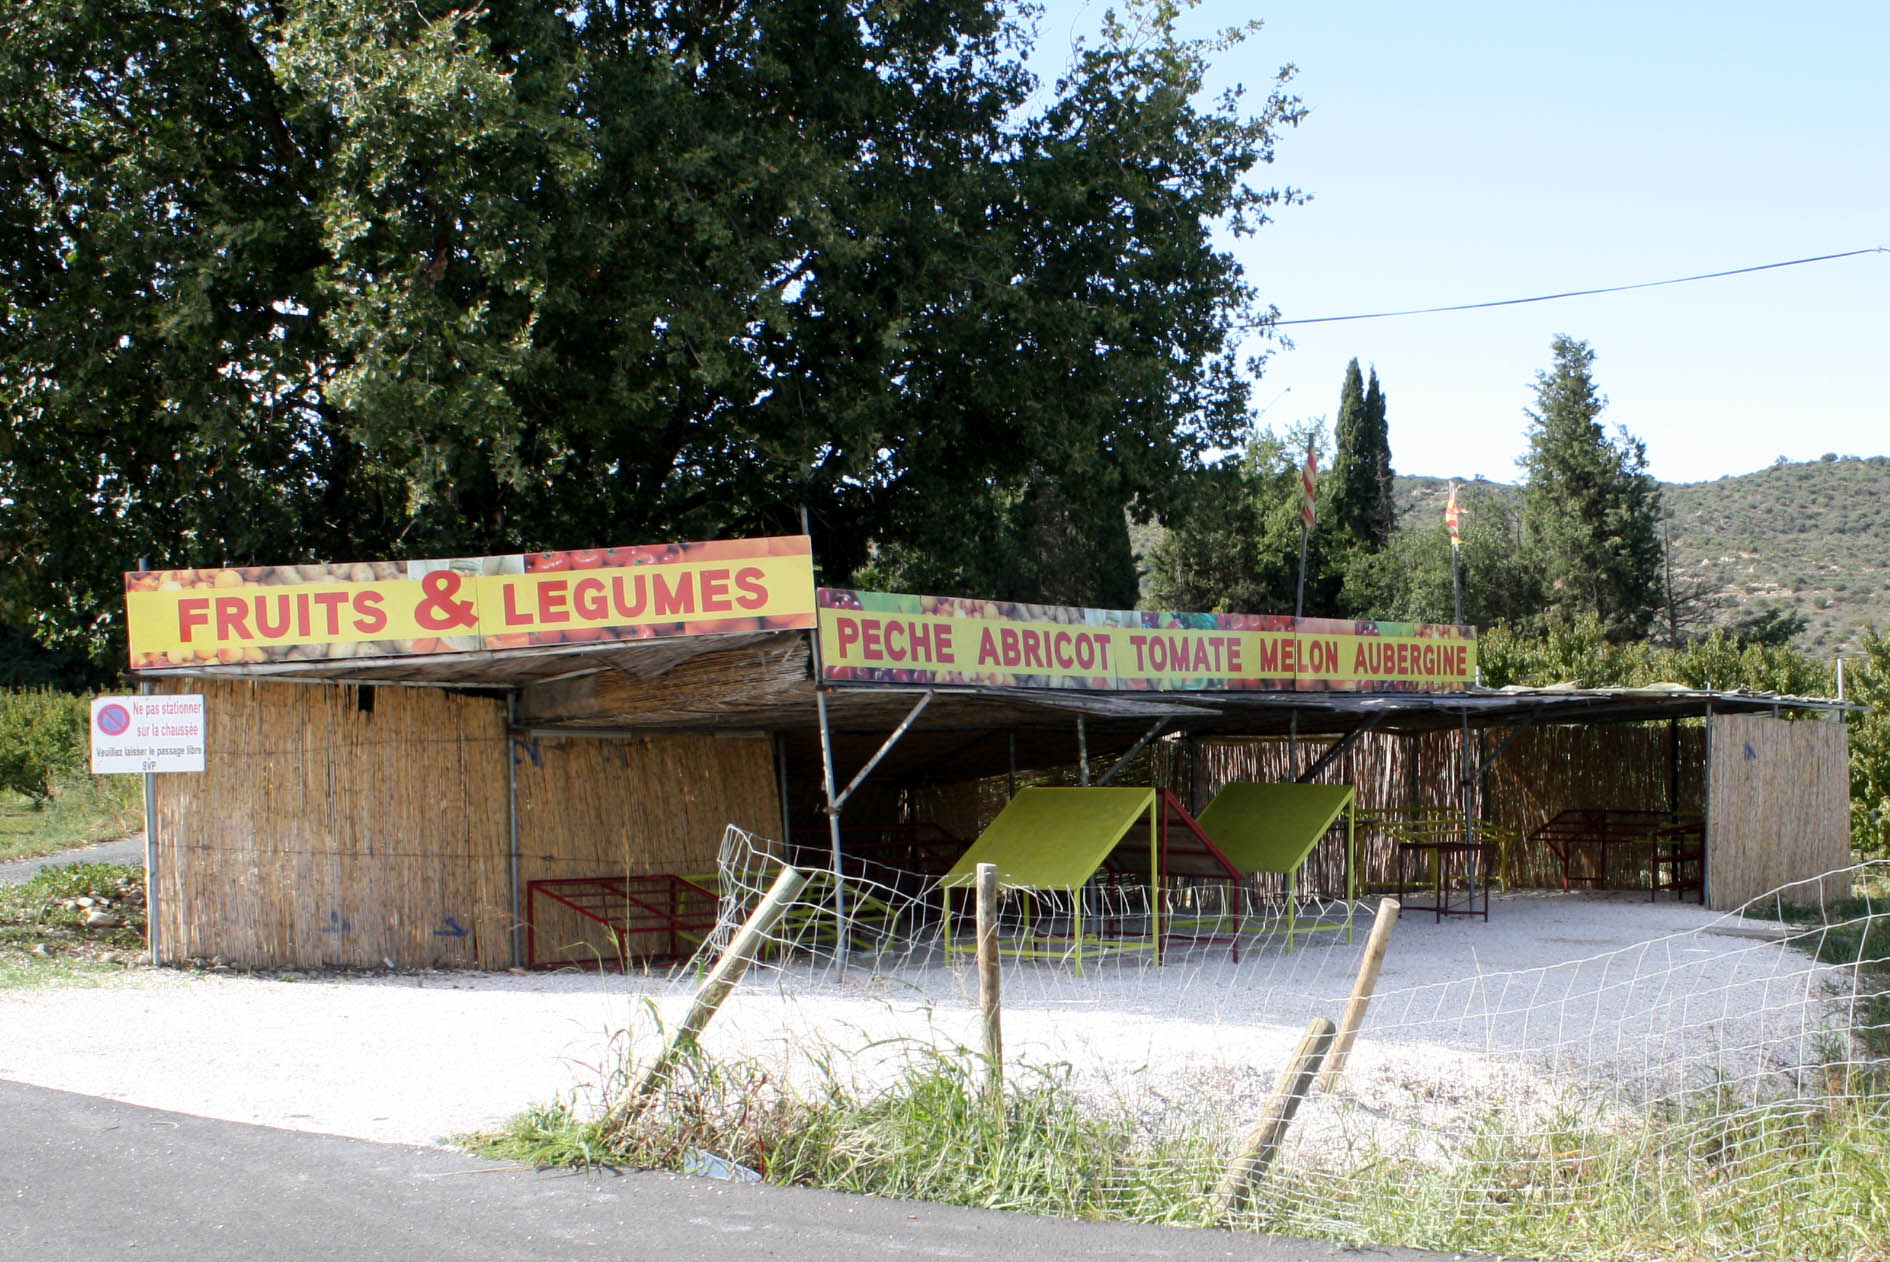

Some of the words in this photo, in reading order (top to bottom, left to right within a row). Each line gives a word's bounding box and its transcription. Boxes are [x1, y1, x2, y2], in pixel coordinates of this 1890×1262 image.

[177, 590, 387, 643] FRUITS
[414, 570, 479, 631] &
[503, 567, 769, 626] LEGUMES
[836, 617, 955, 663] PECHE
[978, 626, 1111, 670] ABRICOT
[1130, 635, 1242, 672] TOMATE
[1260, 638, 1338, 674] MELON
[1353, 642, 1467, 676] AUBERGINE
[133, 703, 143, 714] Ne
[146, 703, 160, 717] pas
[162, 701, 202, 714] stationner
[137, 727, 150, 736] sur
[152, 723, 159, 736] la
[157, 747, 185, 757] passage
[142, 760, 157, 771] SVP
